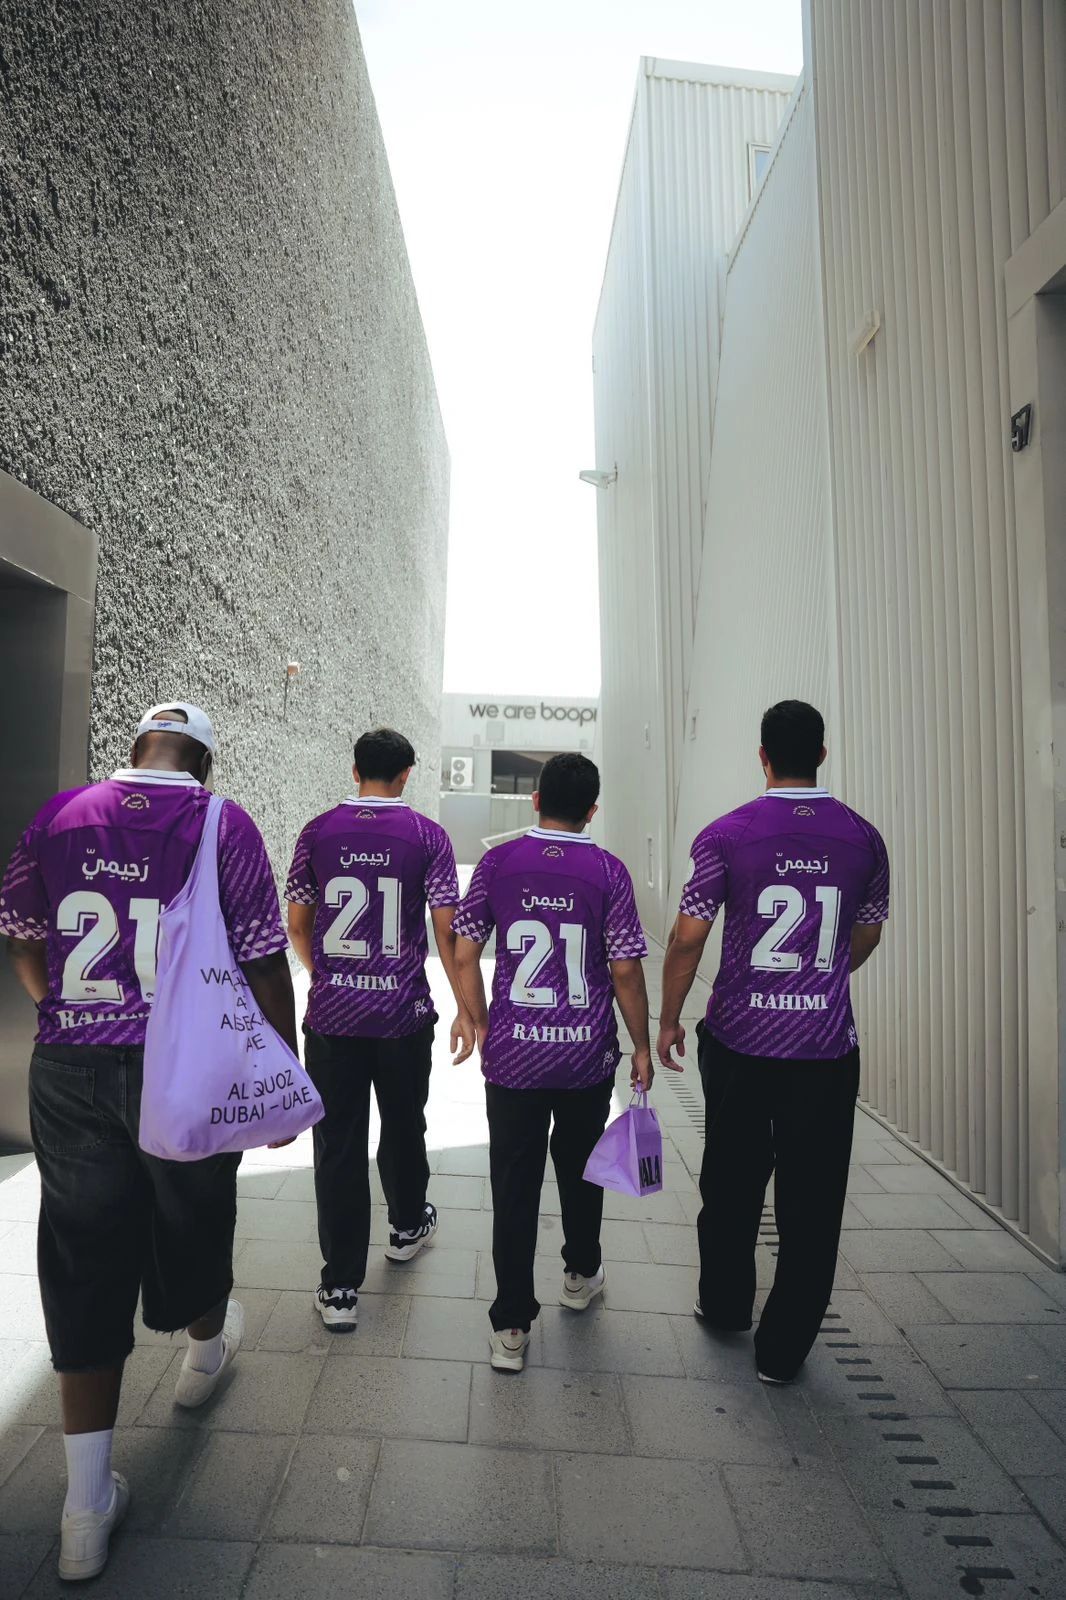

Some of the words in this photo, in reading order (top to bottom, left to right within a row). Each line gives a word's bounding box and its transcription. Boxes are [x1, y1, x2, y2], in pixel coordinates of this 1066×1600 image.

[1011, 403, 1031, 452] 57
[469, 704, 499, 718] we
[503, 705, 536, 719] are
[323, 876, 402, 959] 21
[750, 885, 841, 972] 21
[57, 890, 165, 1005] 21
[506, 920, 589, 1008] 21
[330, 973, 399, 991] RAHIMI
[749, 992, 829, 1010] RAHIMI
[512, 1023, 592, 1043] RAHIMI
[227, 1082, 249, 1100] AL
[253, 1069, 294, 1098] QUOZ
[210, 1102, 265, 1124] DUBAI
[282, 1086, 313, 1111] UAE
